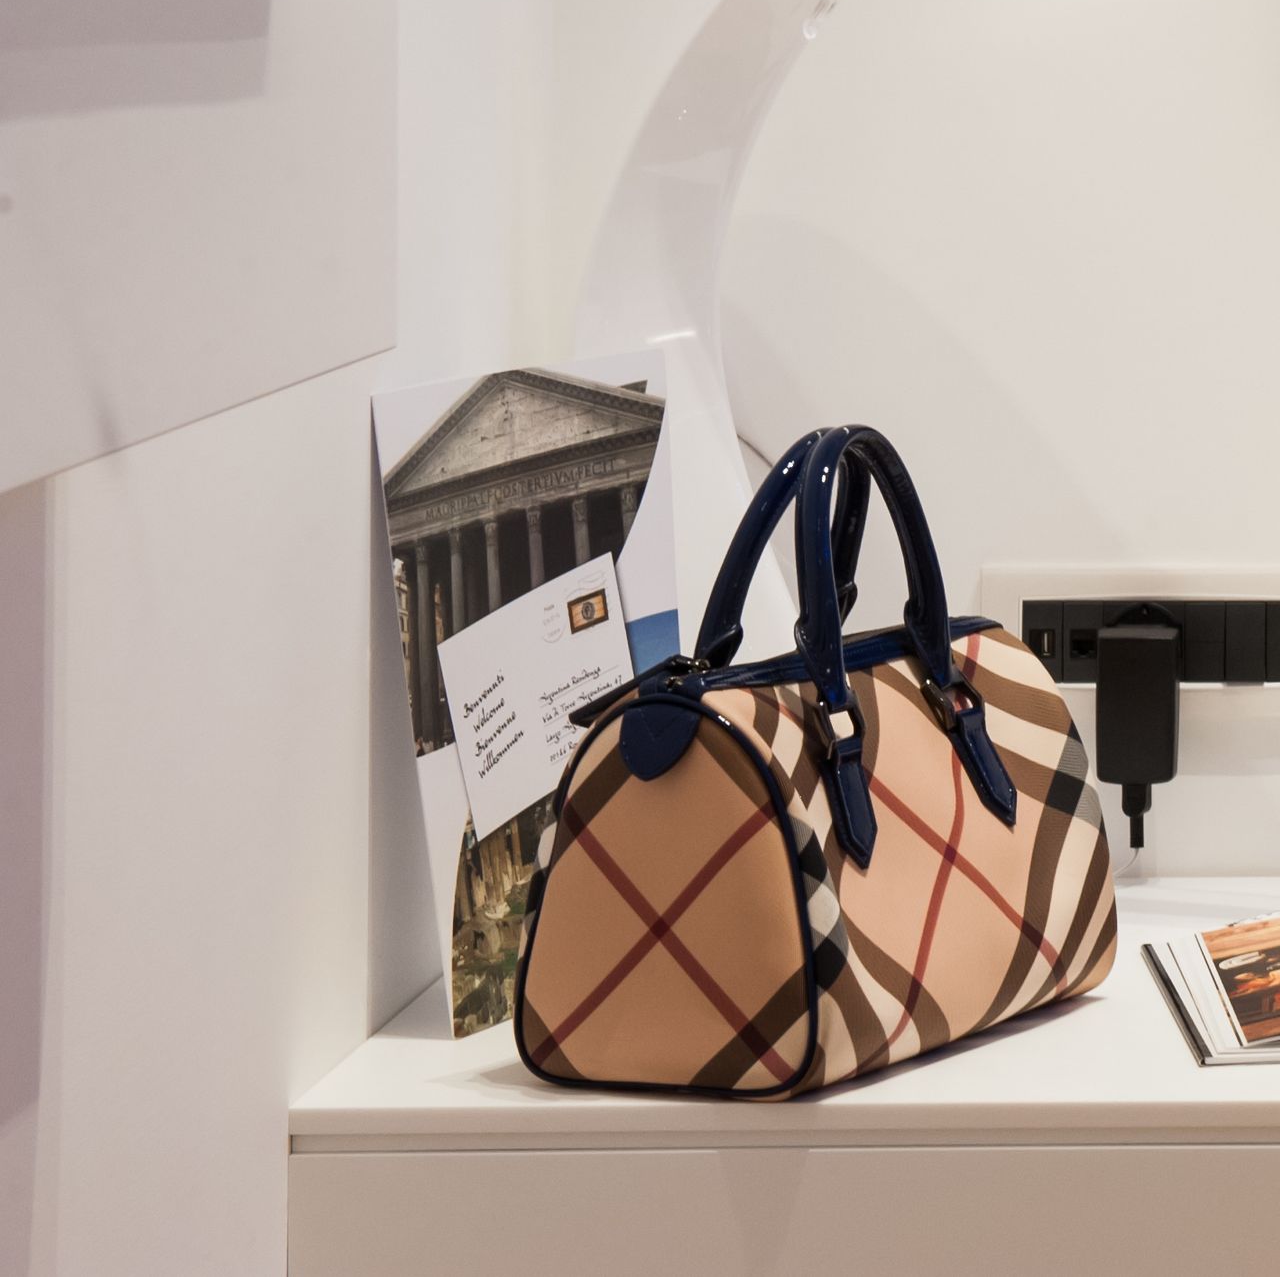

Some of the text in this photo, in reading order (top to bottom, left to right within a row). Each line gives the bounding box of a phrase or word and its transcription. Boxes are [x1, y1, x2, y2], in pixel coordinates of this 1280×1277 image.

[463, 667, 505, 719] Benvenuti
[473, 697, 506, 734] Welcome
[475, 710, 517, 758] Bienvenue
[478, 729, 525, 779] Willkommen
